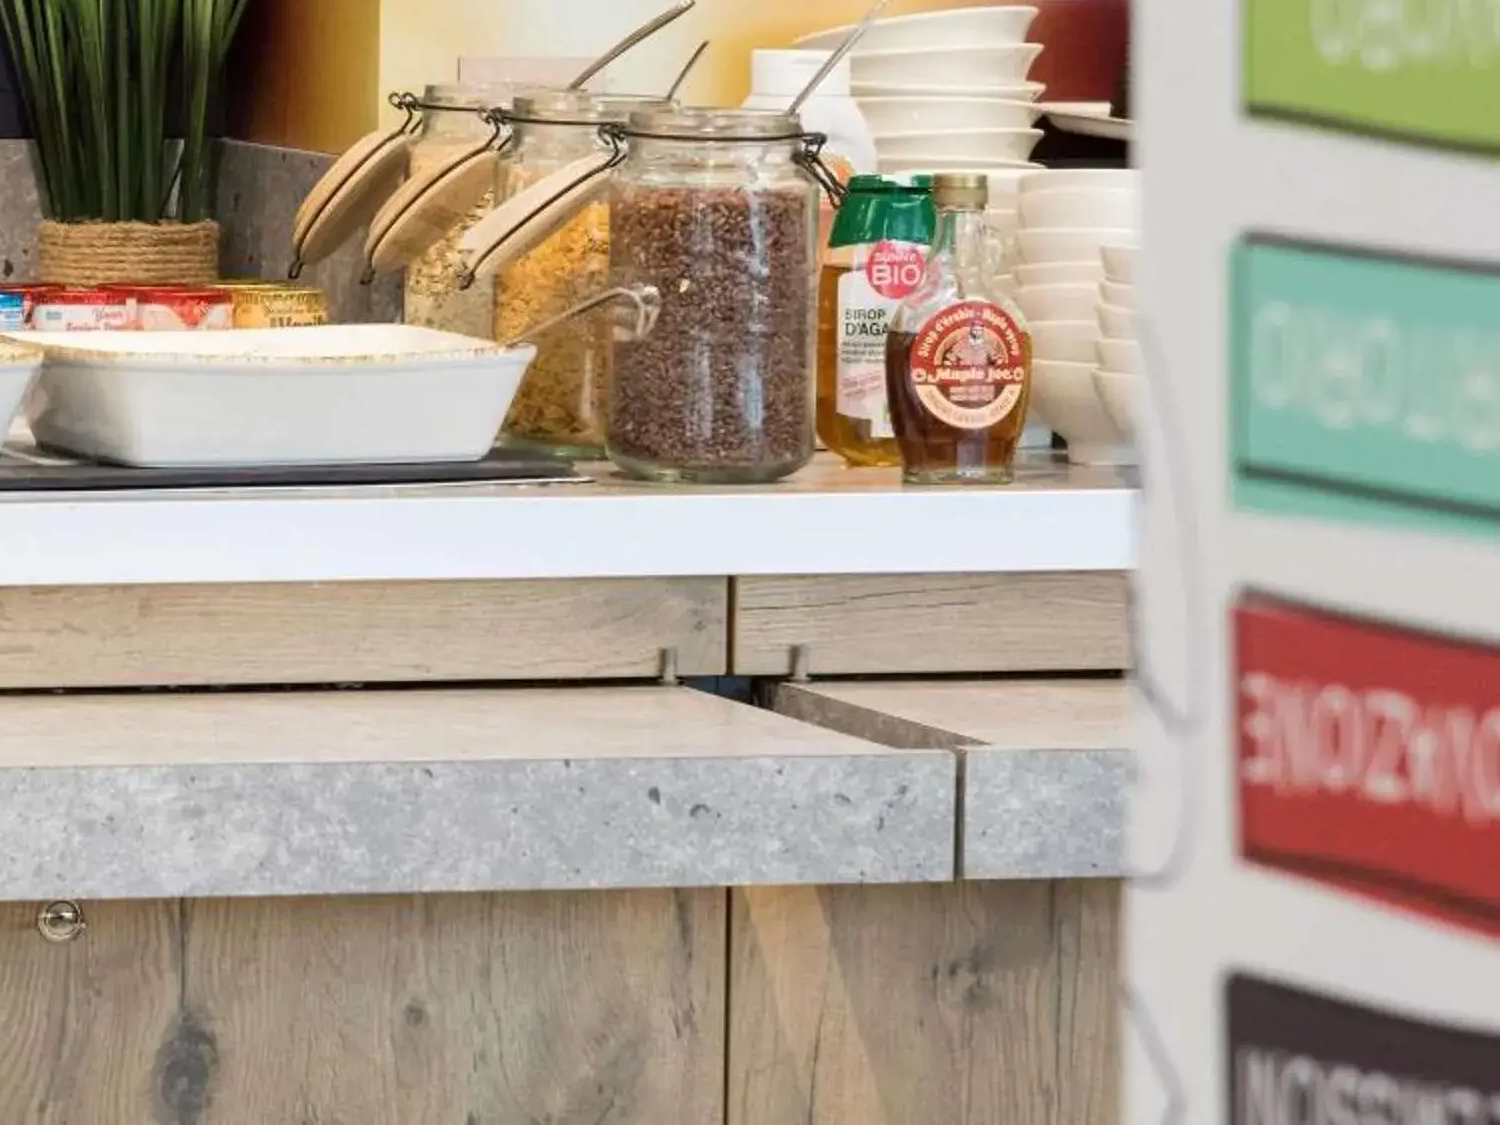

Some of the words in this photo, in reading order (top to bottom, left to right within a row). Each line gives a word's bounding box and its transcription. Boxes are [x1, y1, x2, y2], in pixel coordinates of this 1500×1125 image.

[872, 264, 921, 286] BIO
[845, 308, 887, 320] SIROP
[846, 322, 891, 336] D'AGA
